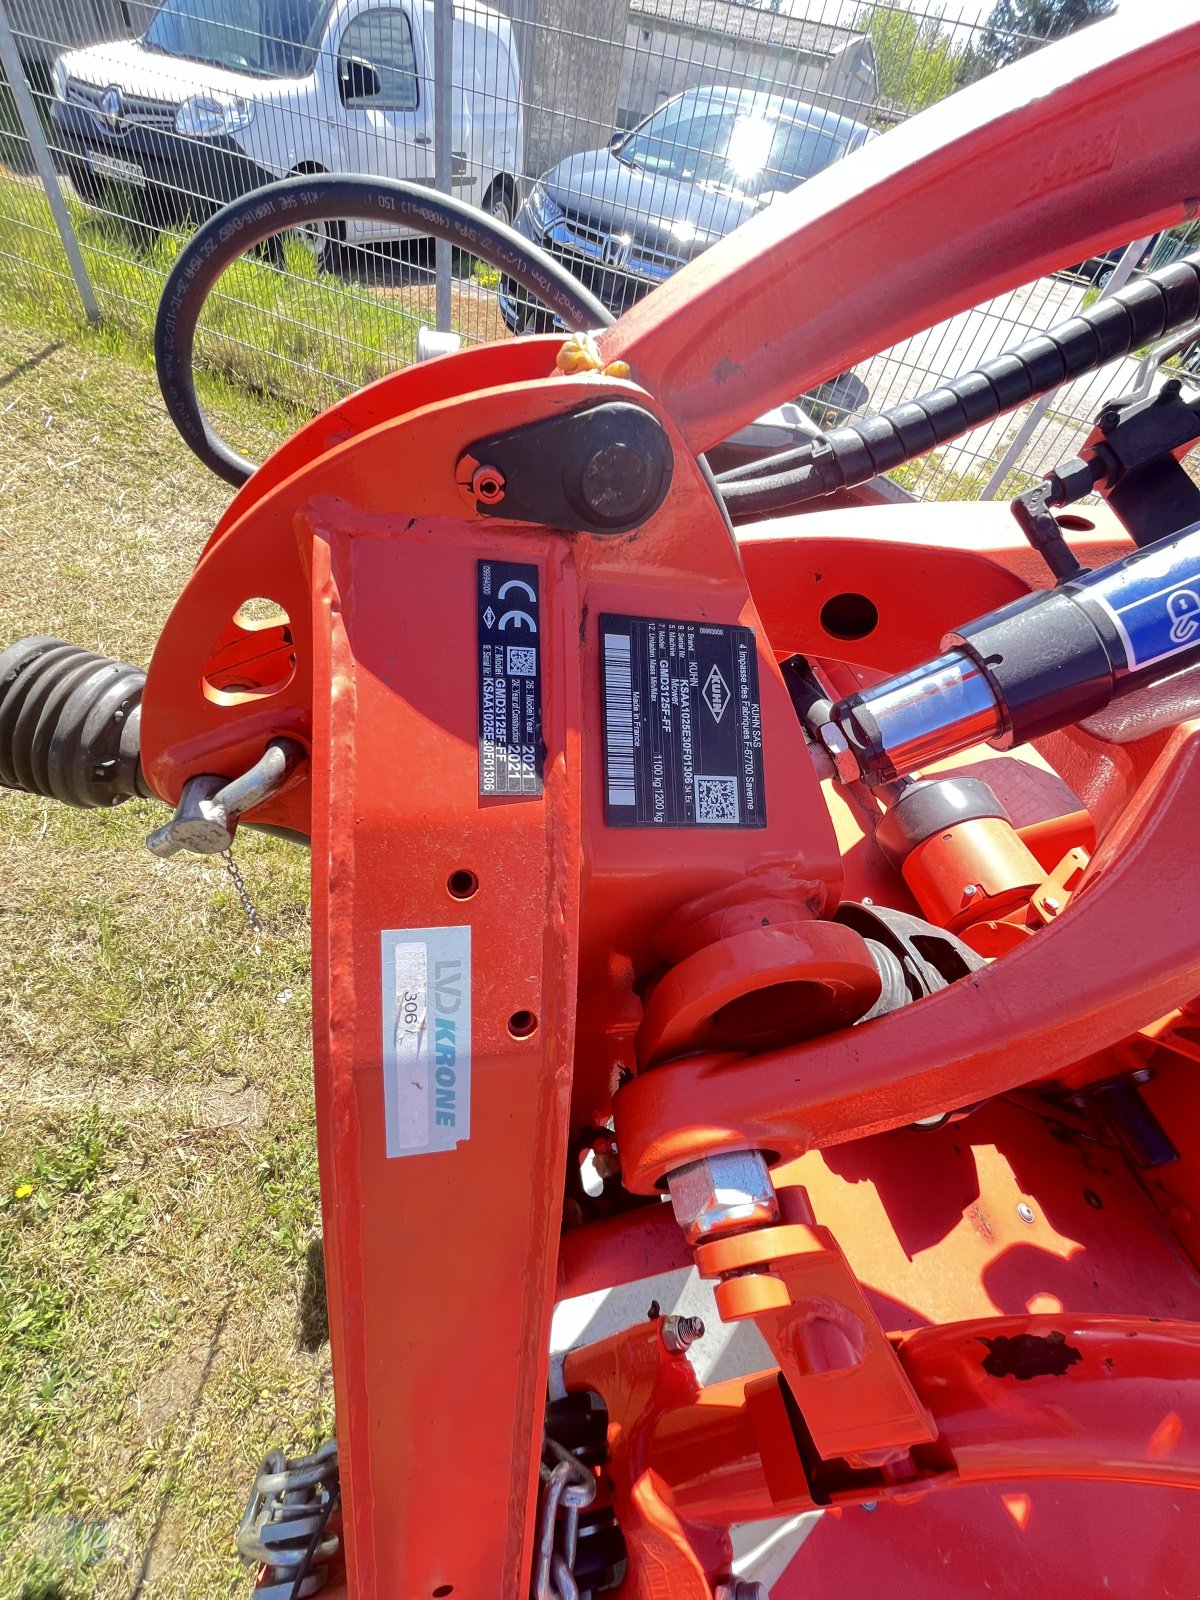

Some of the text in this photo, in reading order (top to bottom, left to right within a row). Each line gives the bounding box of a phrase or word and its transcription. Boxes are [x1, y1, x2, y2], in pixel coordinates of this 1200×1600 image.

[378, 195, 395, 210] ISO
[483, 652, 491, 667] Serial
[689, 662, 698, 686] KUHN
[738, 651, 747, 683] Impasse
[660, 660, 671, 732] GMD3125F-FF
[671, 678, 679, 705] Mower
[711, 675, 721, 712] KUHN
[483, 677, 494, 790] KSAA1025E30F01306
[496, 679, 506, 762] GMD3125F-FF
[680, 679, 692, 783] KSAA1025E30F01306
[740, 701, 751, 739] Fabriques
[753, 730, 761, 747] SAS
[508, 746, 520, 779] 2021
[523, 746, 535, 779] 2021
[654, 755, 662, 775] 1100
[744, 742, 753, 774] F-67700
[653, 777, 663, 787] kg
[655, 789, 664, 809] 1200
[654, 812, 664, 822] kg
[435, 960, 462, 1127] LVD KRONE
